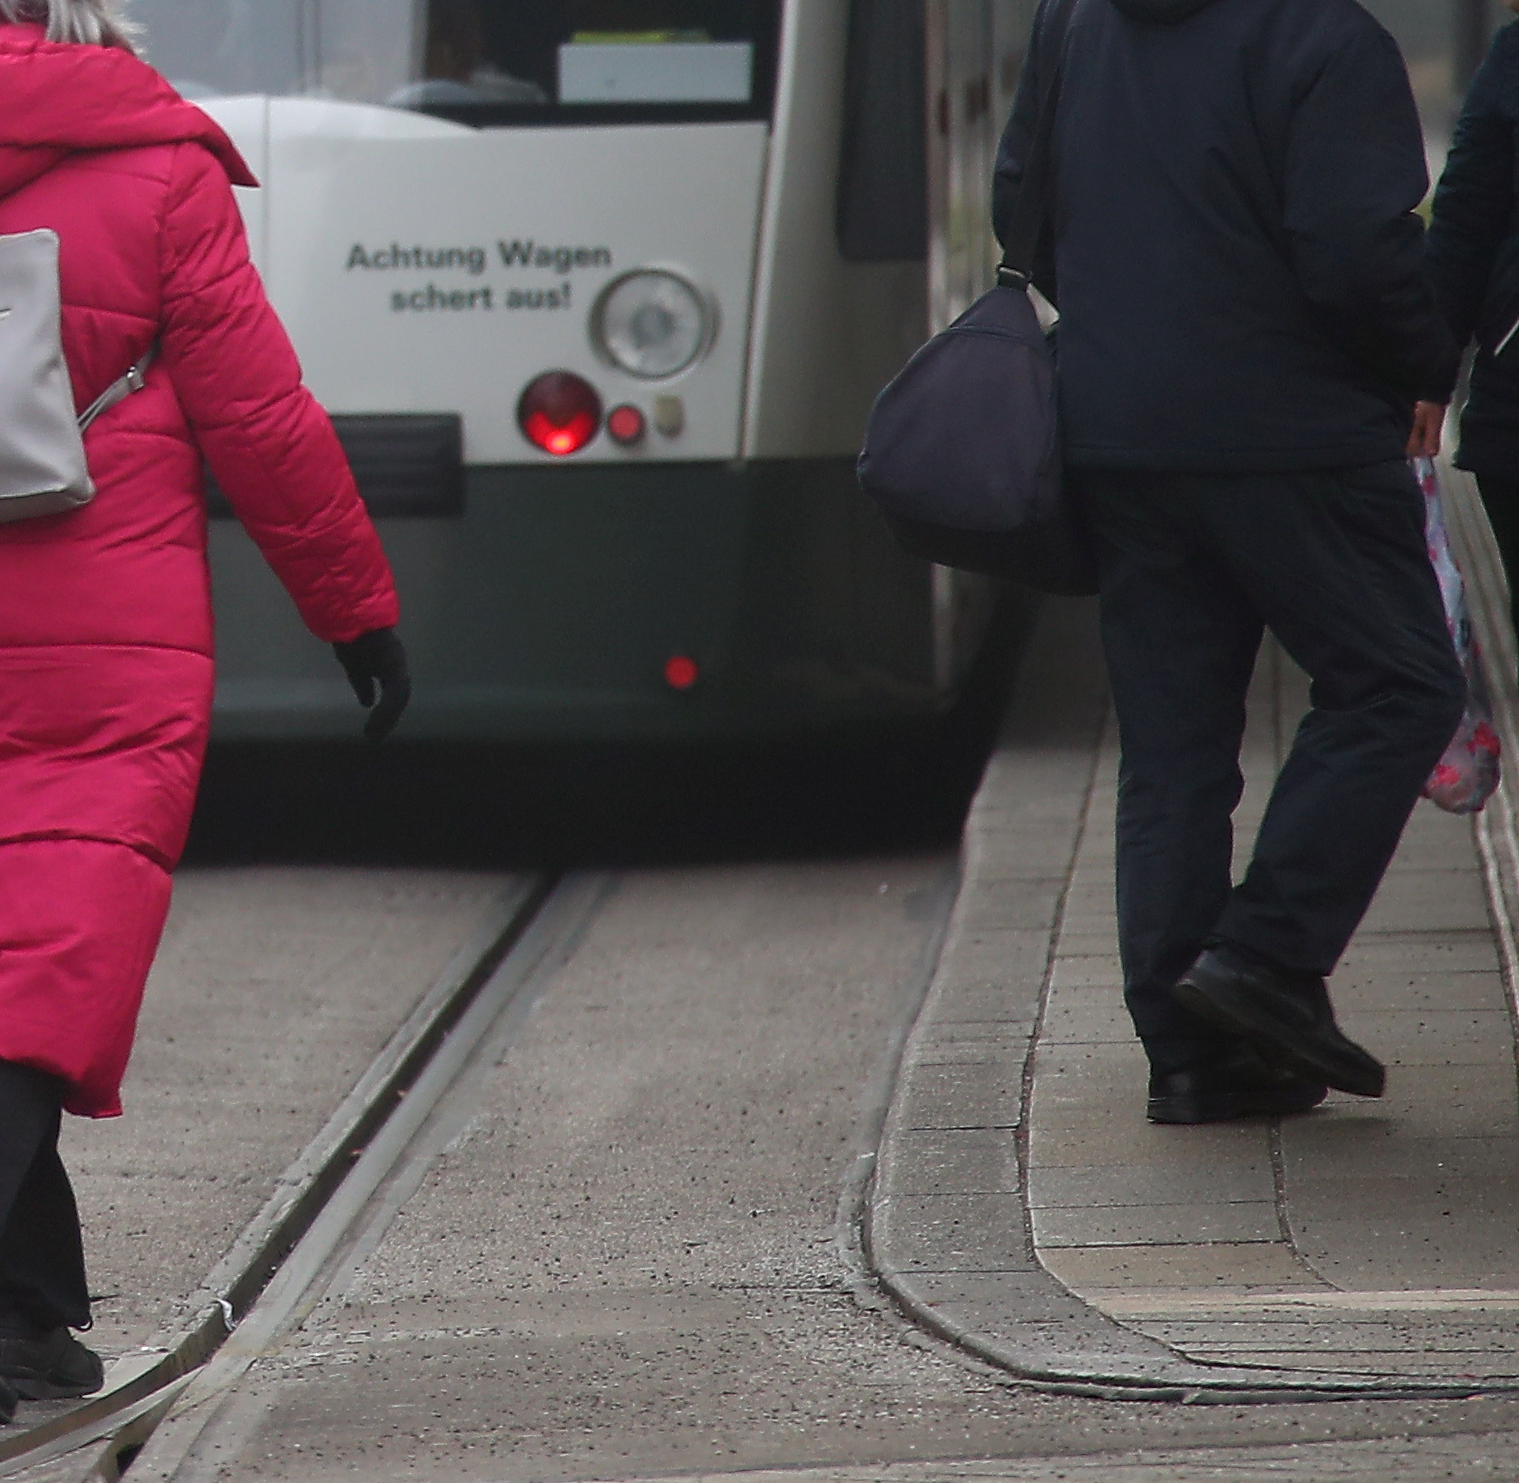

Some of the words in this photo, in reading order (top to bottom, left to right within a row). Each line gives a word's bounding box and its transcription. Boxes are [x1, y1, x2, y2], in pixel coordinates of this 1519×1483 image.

[346, 241, 487, 275] Achtung
[496, 237, 612, 274] Wagen
[390, 281, 493, 312] schert
[506, 280, 572, 311] aus!
